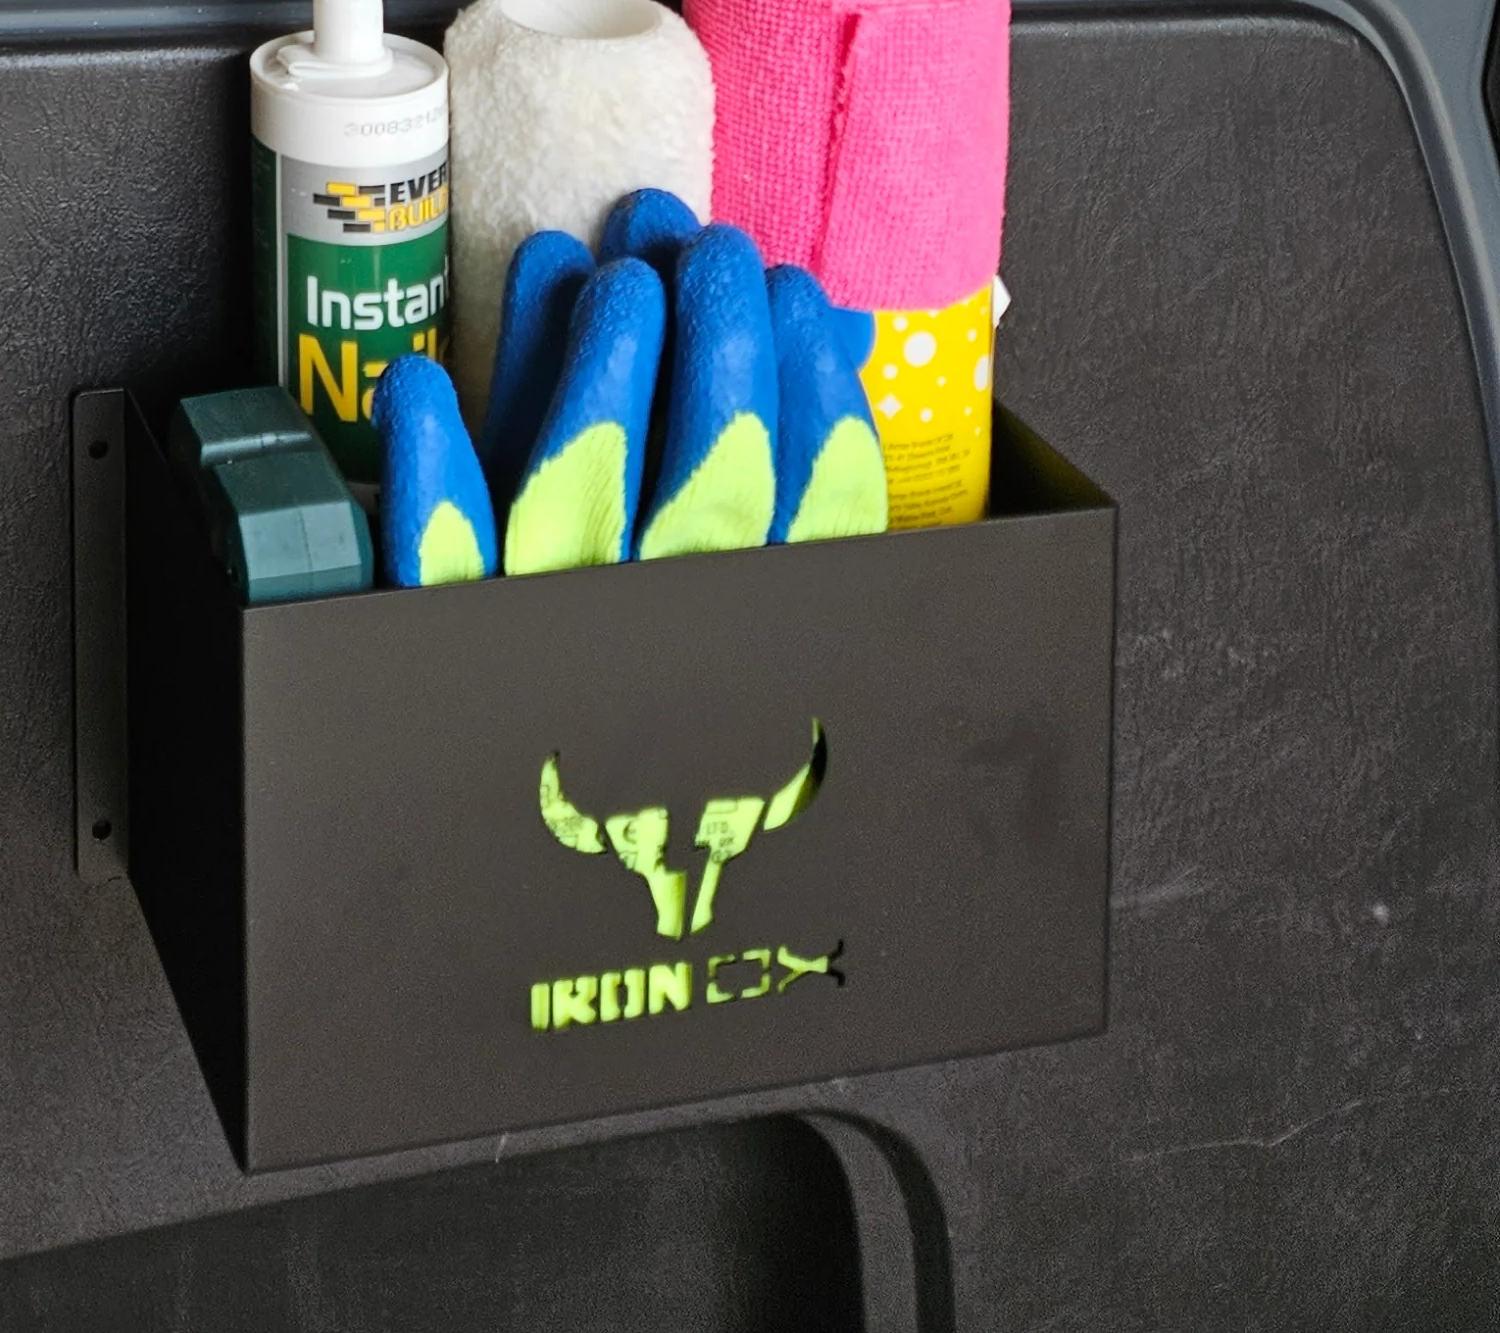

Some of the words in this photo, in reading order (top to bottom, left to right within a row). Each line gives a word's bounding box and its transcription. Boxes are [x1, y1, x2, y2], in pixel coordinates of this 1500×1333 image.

[390, 161, 447, 205] EVER
[307, 263, 449, 330] Instan
[530, 961, 692, 1030] IRON
